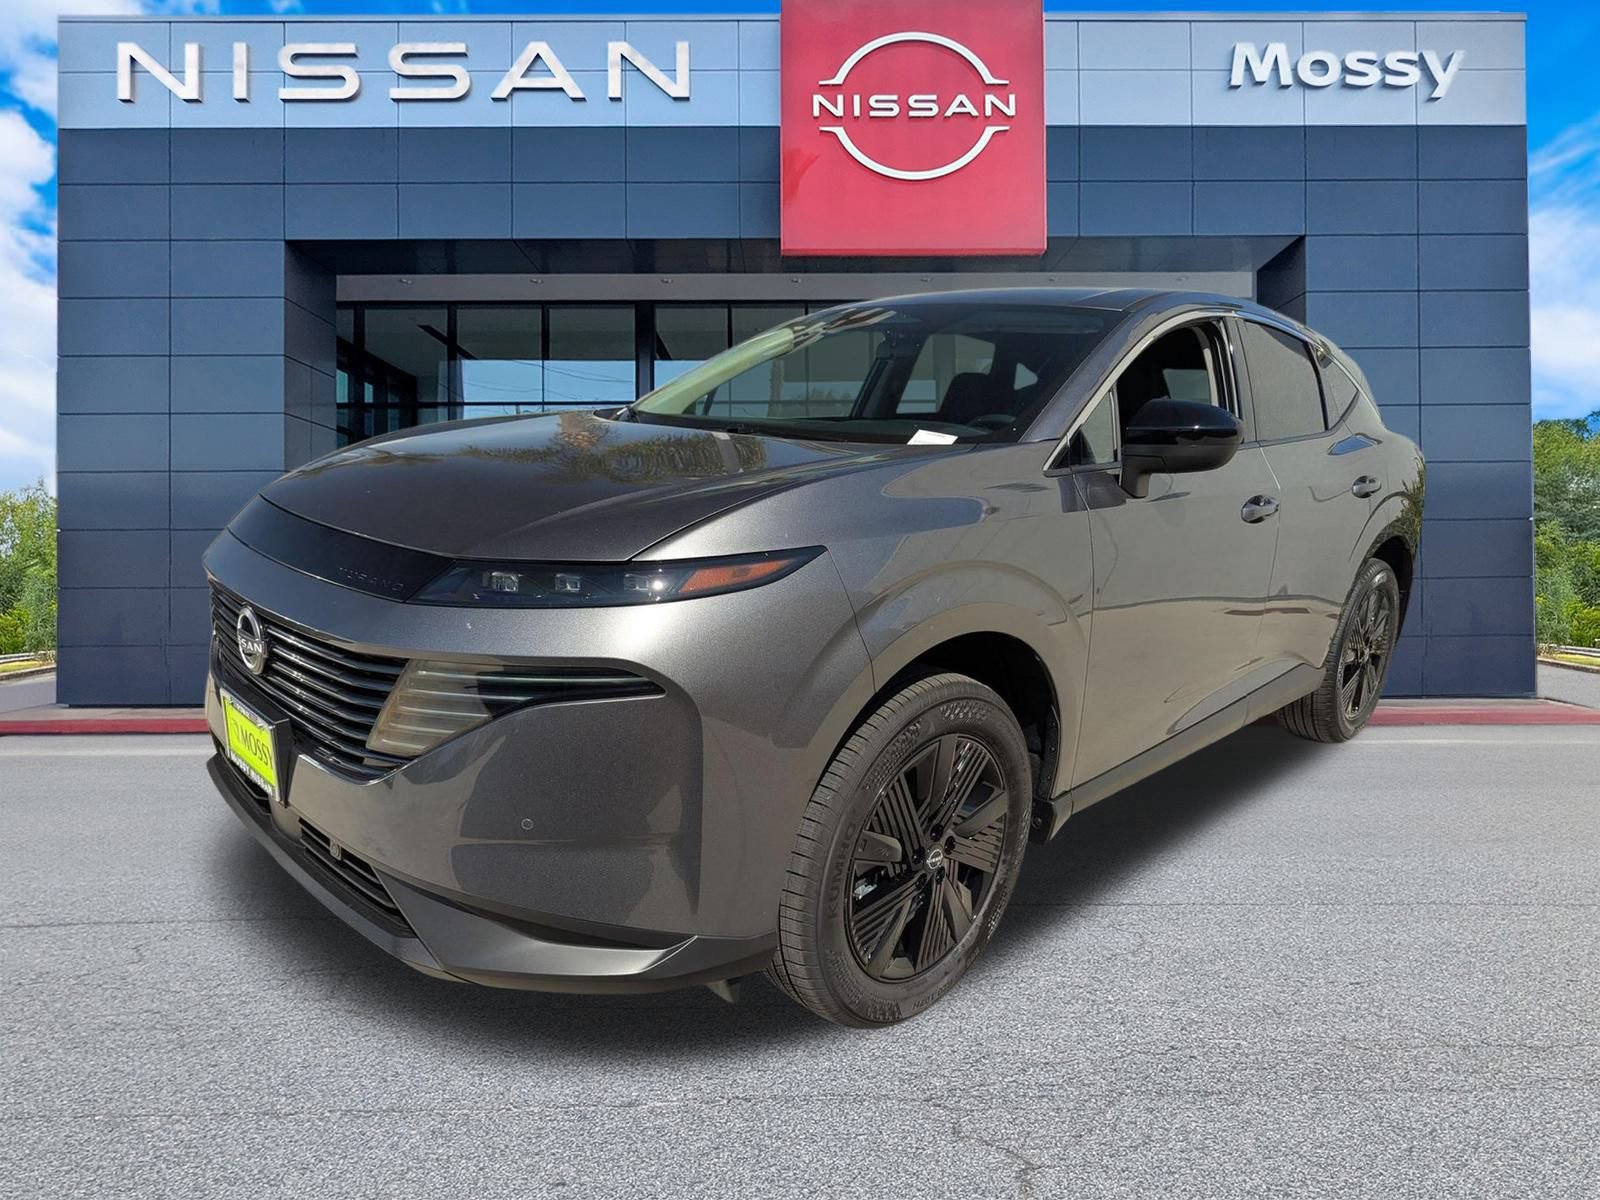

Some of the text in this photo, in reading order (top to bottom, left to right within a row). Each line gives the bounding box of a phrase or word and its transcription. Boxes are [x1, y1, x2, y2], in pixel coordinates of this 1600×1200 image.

[117, 41, 690, 101] NISSAN
[1229, 41, 1466, 100] Mossy
[812, 94, 1016, 118] NISSAN
